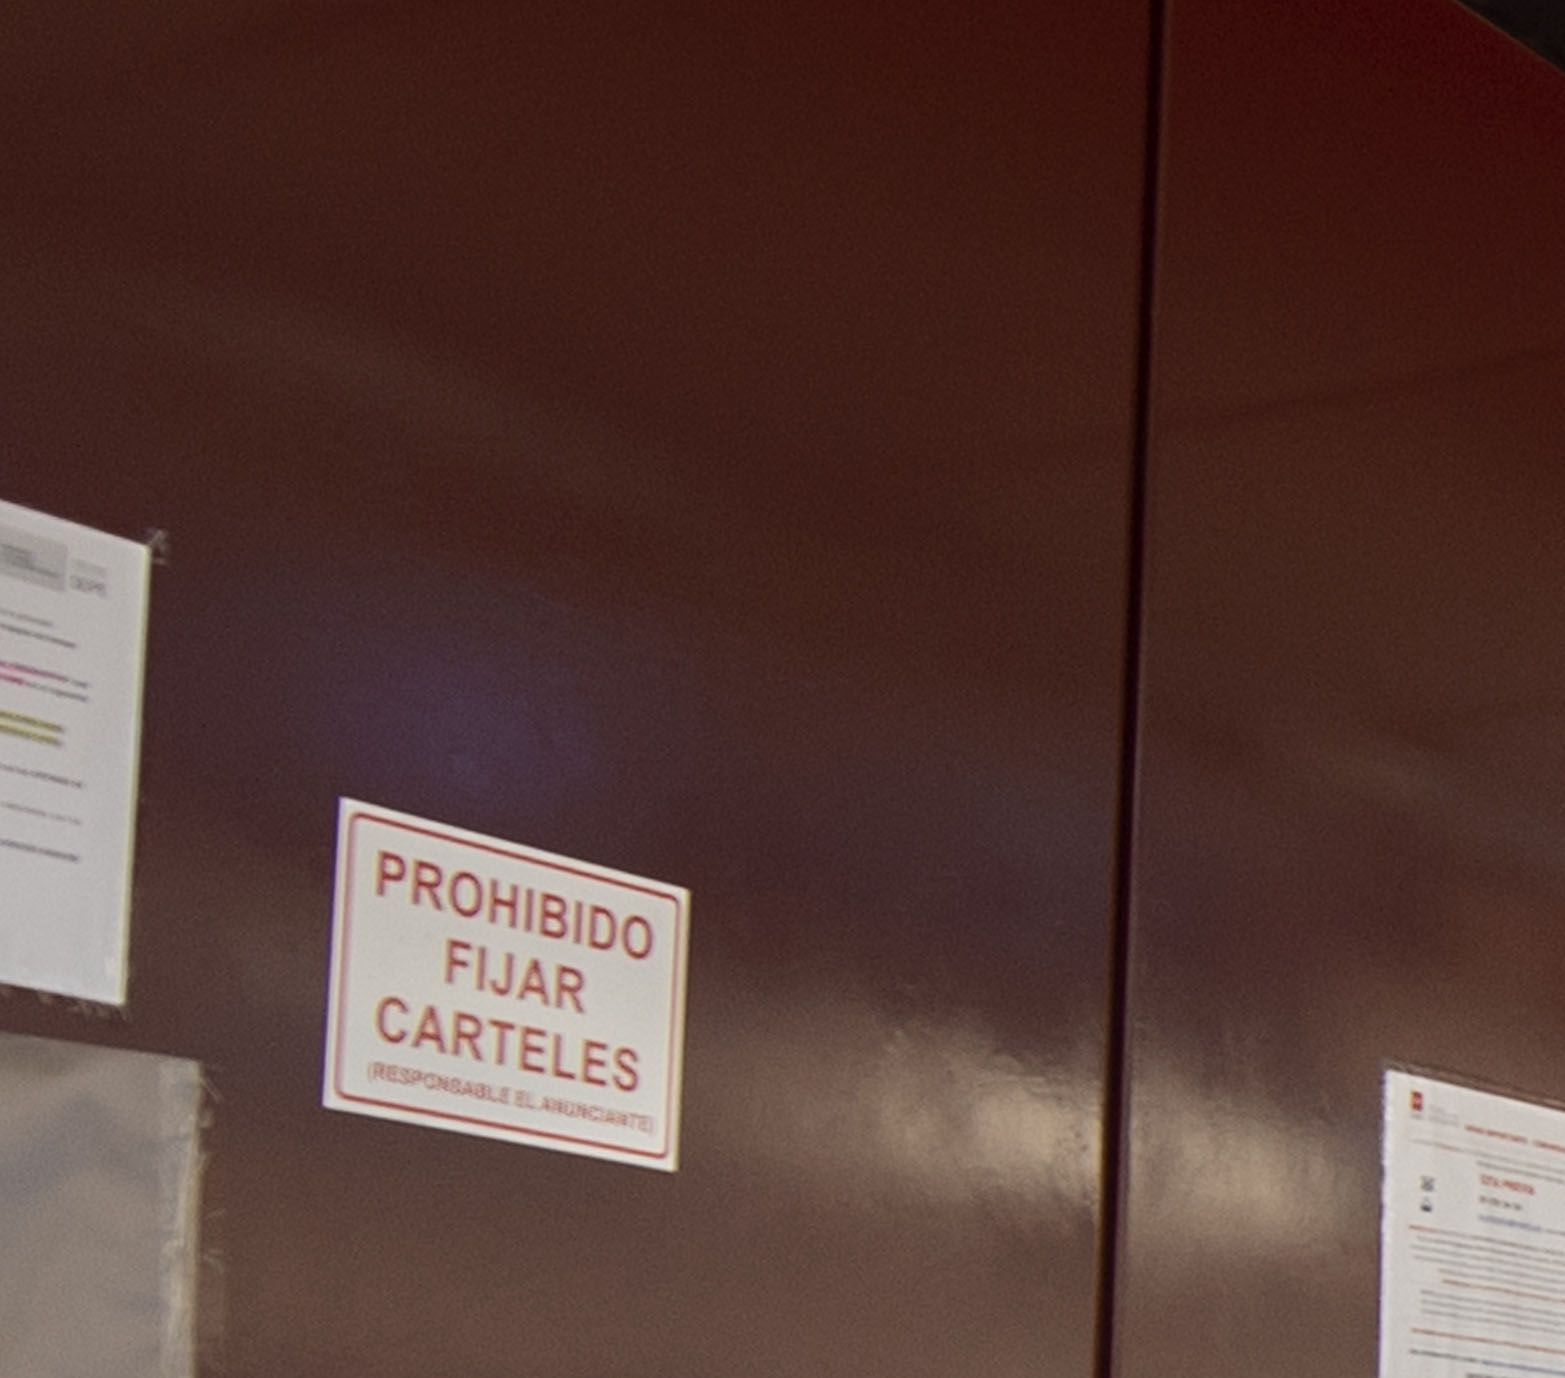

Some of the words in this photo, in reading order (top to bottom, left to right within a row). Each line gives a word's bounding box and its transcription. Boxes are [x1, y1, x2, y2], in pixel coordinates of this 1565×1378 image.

[376, 850, 654, 959] PROHIBIDO
[444, 938, 585, 1014] FIJAR
[375, 995, 639, 1092] CARTELES
[368, 1061, 510, 1105] (RESPONSABLE
[513, 1089, 537, 1111] EL
[540, 1096, 657, 1134] ANUNCIANTE)
